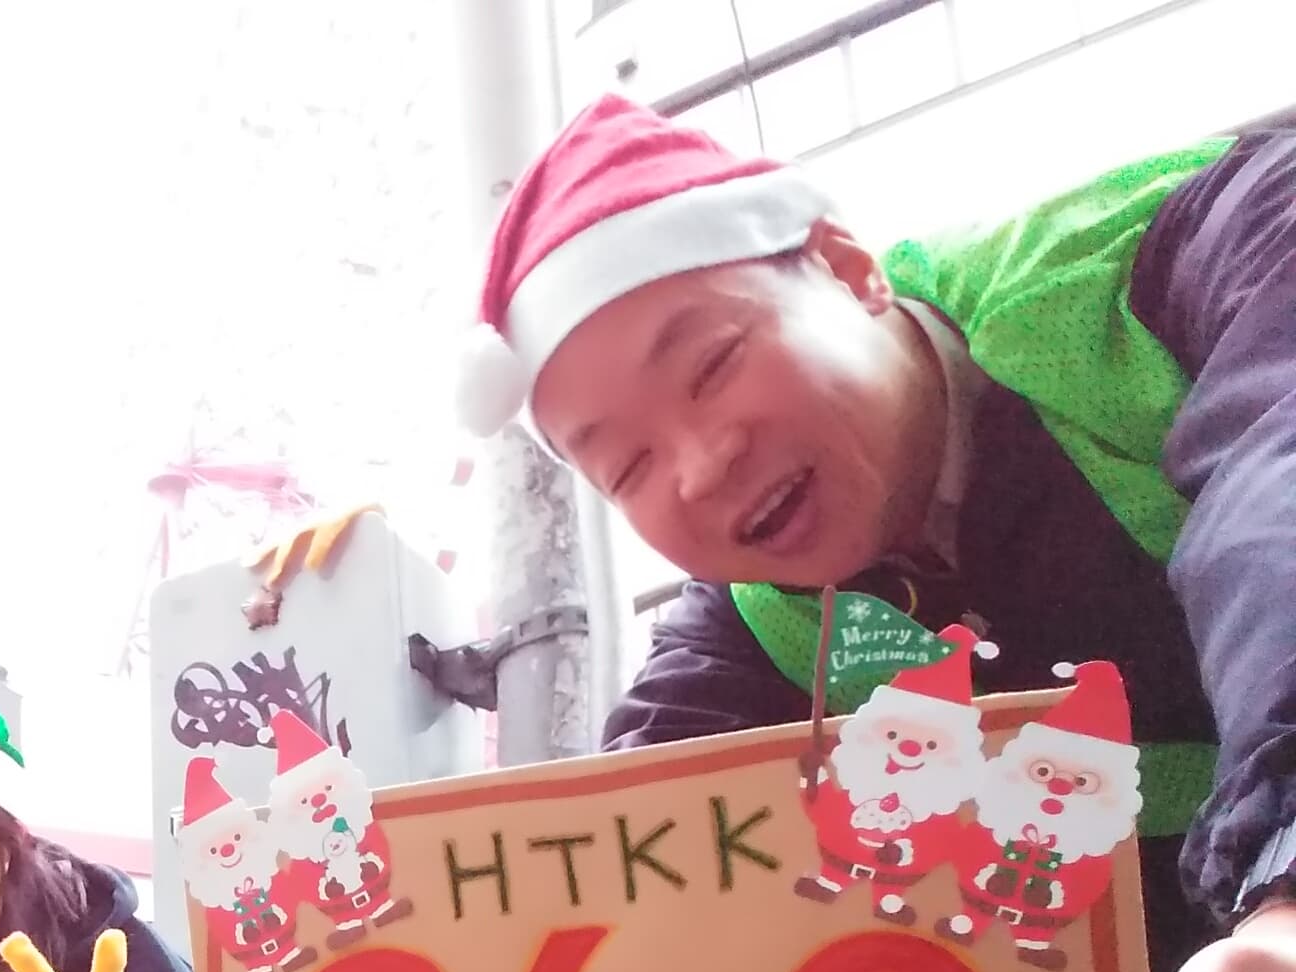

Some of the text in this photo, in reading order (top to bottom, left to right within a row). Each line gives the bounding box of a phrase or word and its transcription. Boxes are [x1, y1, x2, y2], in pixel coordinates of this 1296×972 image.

[840, 626, 912, 646] Merry
[830, 650, 929, 671] Christmas
[443, 795, 782, 921] HTKK
